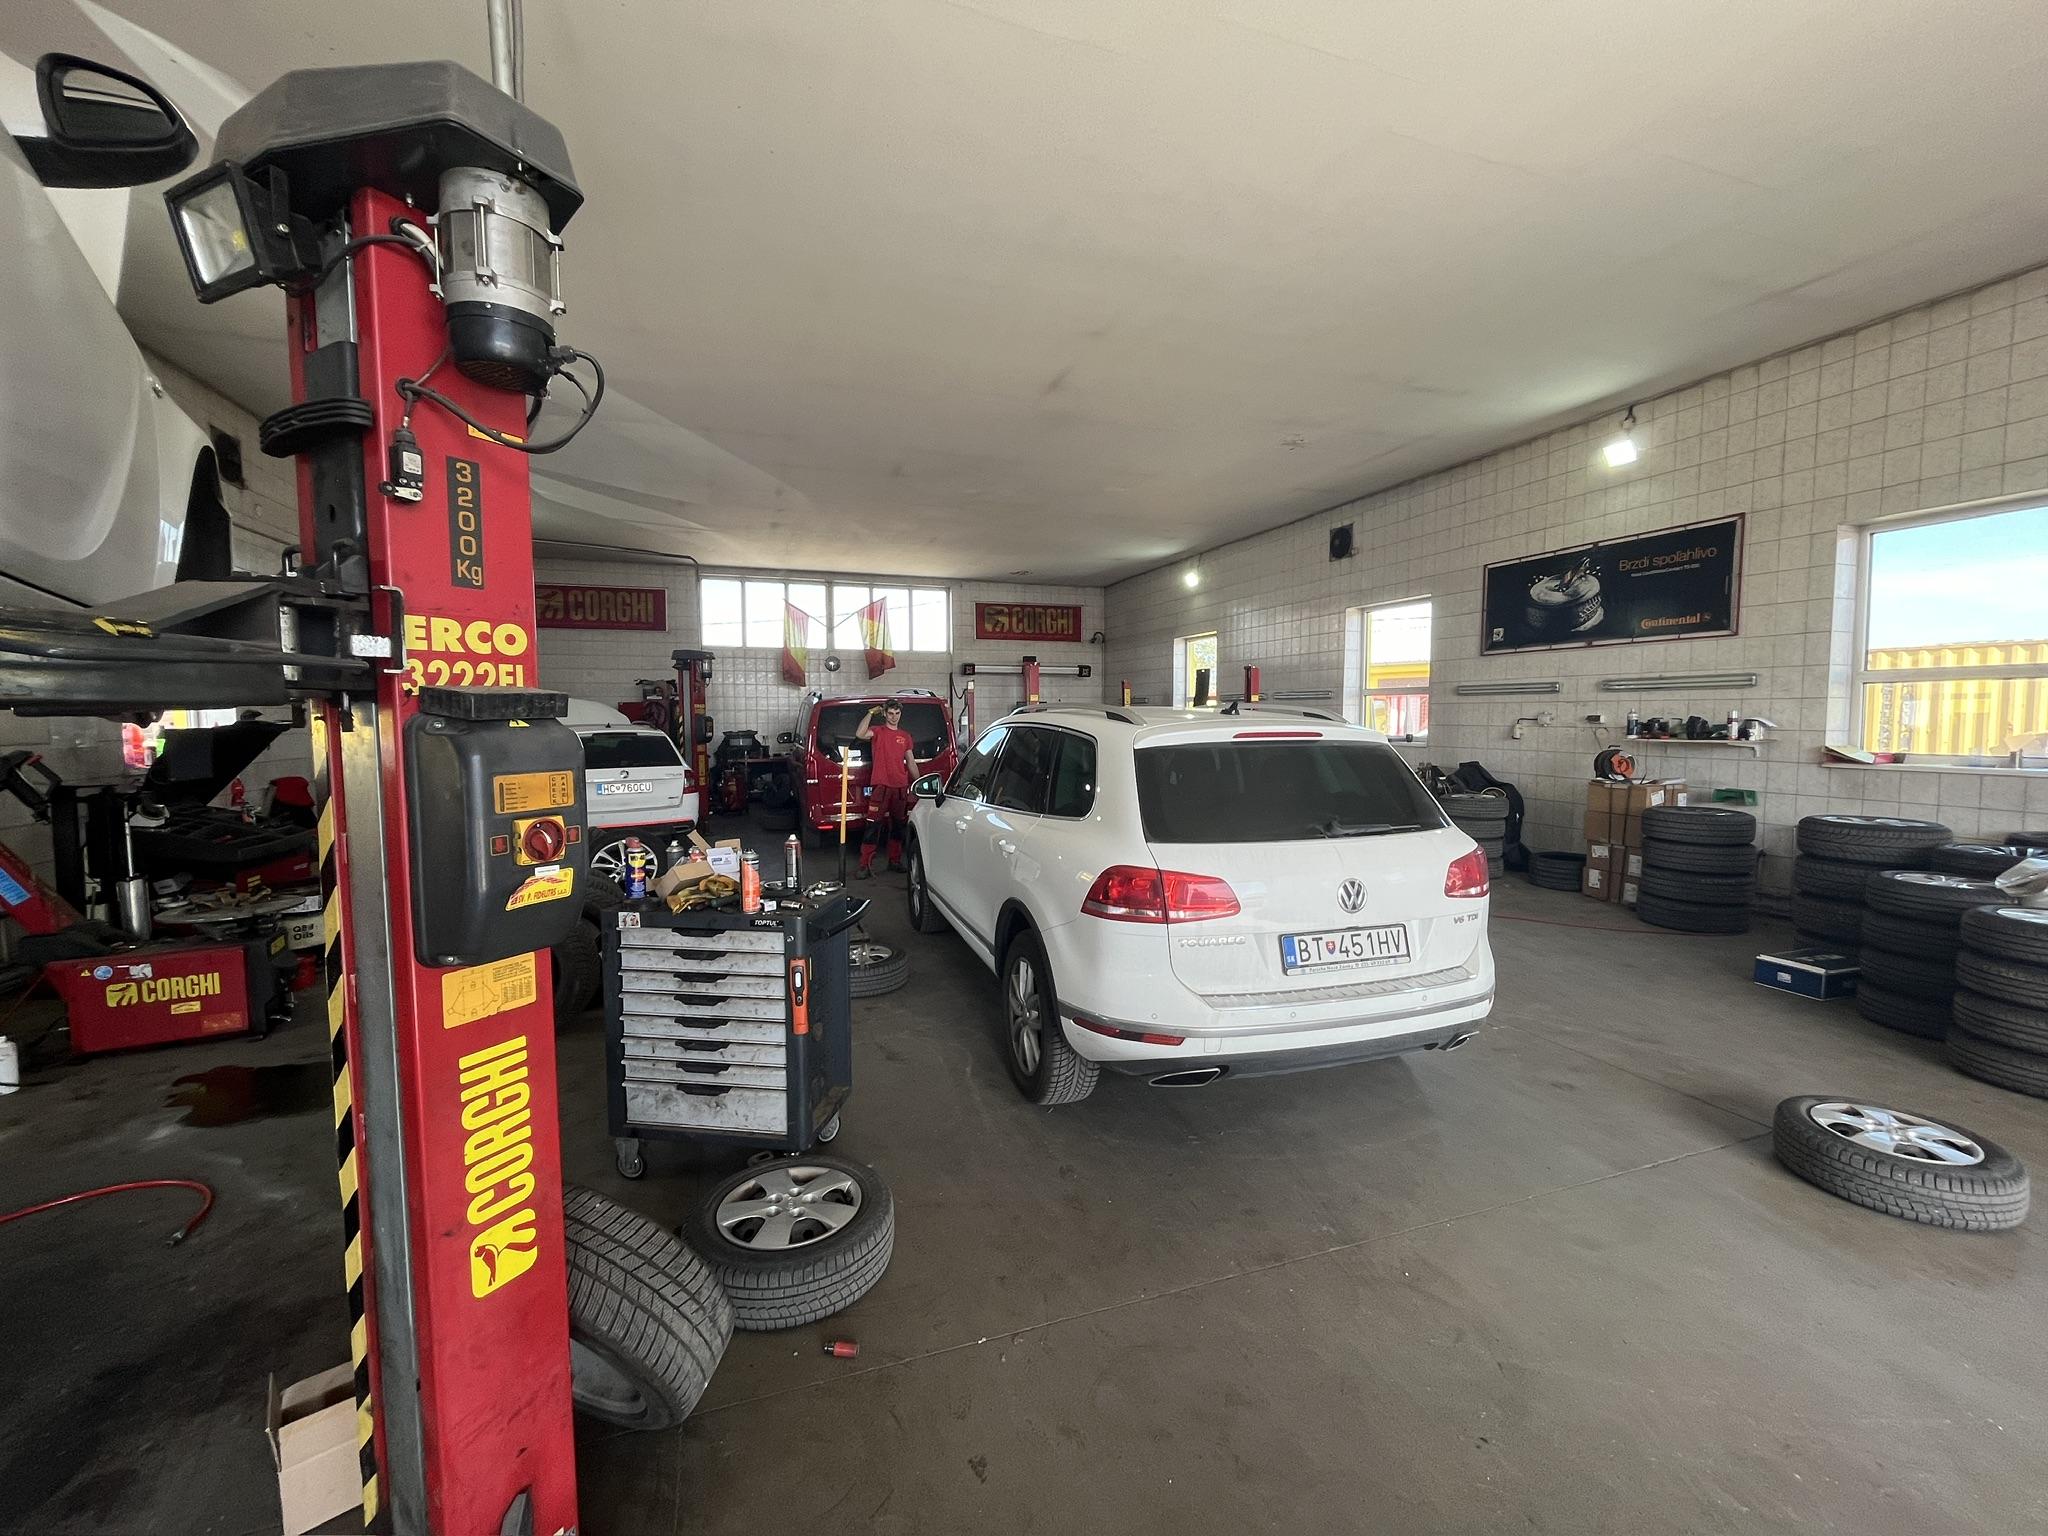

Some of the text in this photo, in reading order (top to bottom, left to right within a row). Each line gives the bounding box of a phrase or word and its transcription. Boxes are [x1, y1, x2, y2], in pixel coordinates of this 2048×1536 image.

[568, 589, 655, 623] CORGHI
[1011, 606, 1073, 635] CORGHI
[1640, 613, 1701, 630] Continental
[404, 614, 528, 656] ERCO
[1453, 915, 1464, 924] V6
[1298, 929, 1400, 963] BT 451HV
[141, 972, 221, 1003] CORGHI
[458, 1035, 535, 1225] CORGHI
